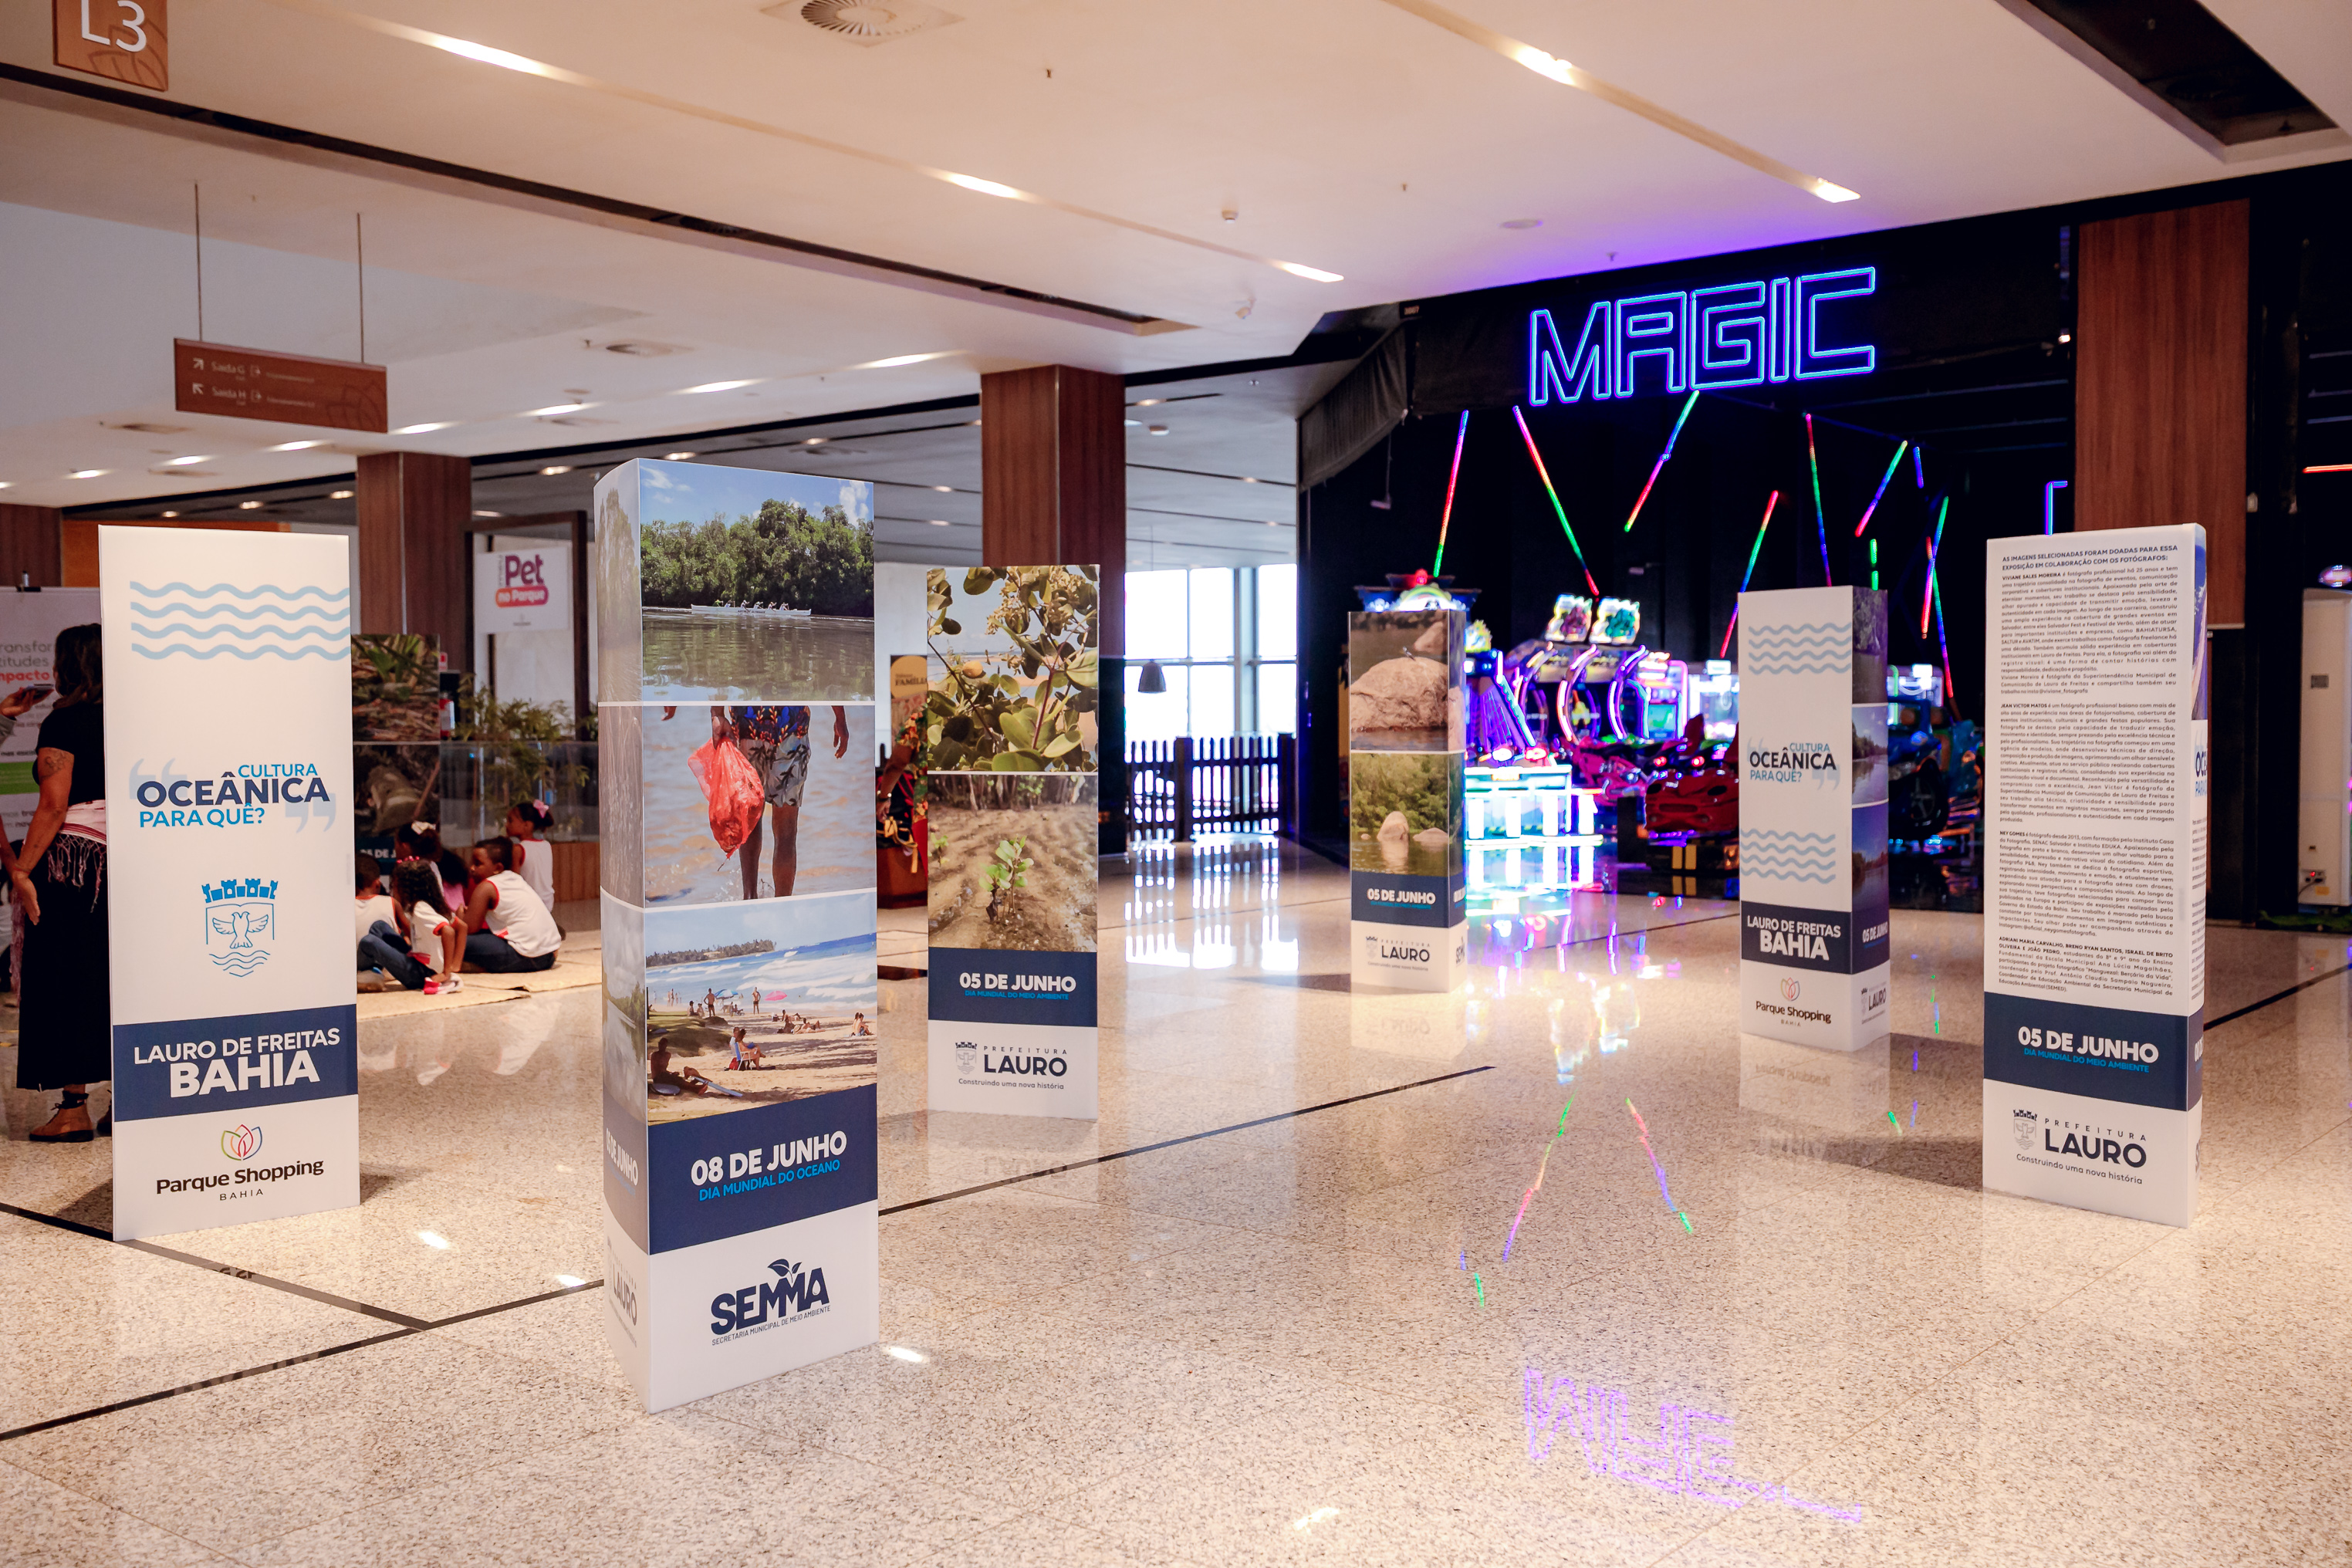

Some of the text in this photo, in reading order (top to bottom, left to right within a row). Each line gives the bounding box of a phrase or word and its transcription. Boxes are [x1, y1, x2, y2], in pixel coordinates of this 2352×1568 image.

[81, 0, 147, 52] L3
[1531, 267, 1875, 405] MAGIC
[2002, 562, 2034, 571] EXPOSIÇÃO
[2044, 559, 2092, 568] COLABORAÇÃO
[2120, 553, 2168, 563] FOTÓGRAFOS:
[2037, 550, 2083, 559] SELECIONADAS
[2108, 546, 2138, 555] DOADAS
[505, 554, 543, 586] Pet
[512, 589, 545, 603] Parque
[1749, 747, 1837, 770] OCEÂNICA
[1789, 742, 1830, 752] CULTURA
[238, 763, 318, 778] CULTURA
[1750, 769, 1802, 782] PARA QUÊ?
[137, 771, 330, 808] OCEÂNICA
[140, 802, 265, 828] PARA QUÊ?
[1367, 888, 1380, 901] 05
[1381, 889, 1395, 901] DE
[1396, 890, 1436, 905] JUNHO
[1747, 914, 1841, 938] LAURO DE FREITAS
[1862, 929, 1870, 943] 05
[1870, 927, 1877, 941] DE
[1381, 945, 1430, 962] LAURO
[1760, 929, 1830, 961] BAHIA
[959, 972, 1076, 992] 05 DE JUNHO
[1868, 988, 1887, 1011] LAURO
[1756, 1000, 1831, 1024] Parque Shopping
[1781, 1019, 1801, 1027] BAHIA
[134, 1027, 340, 1064] LAURO DE FREITAS
[984, 1046, 1067, 1055] PREFEITURA
[2018, 1026, 2159, 1063] 05 DE JUNHO
[984, 1054, 1067, 1076] LAURO
[2024, 1048, 2149, 1073] DIA MUNDIAL DO MEIO AMBIENTE
[170, 1049, 320, 1098] BAHIA
[958, 1078, 1000, 1086] Construindo
[2045, 1118, 2147, 1141] PREFEITURA
[691, 1130, 847, 1186] 08 DE JUNHO
[2045, 1128, 2147, 1168] LAURO
[157, 1160, 324, 1194] Parque Shopping
[617, 1144, 639, 1186] JUNHO
[2016, 1153, 2143, 1184] Construindo uma nova história
[699, 1159, 840, 1201] DIA MUNDIAL DO OCEANO
[219, 1188, 263, 1201] BAHIA
[613, 1263, 637, 1326] LAURO
[711, 1267, 830, 1335] SEMMA
[711, 1330, 749, 1346] SECRETARIA
[749, 1320, 780, 1335] MUNICIPAL
[790, 1313, 803, 1323] MEIO
[803, 1305, 831, 1320] AMBIENTE
